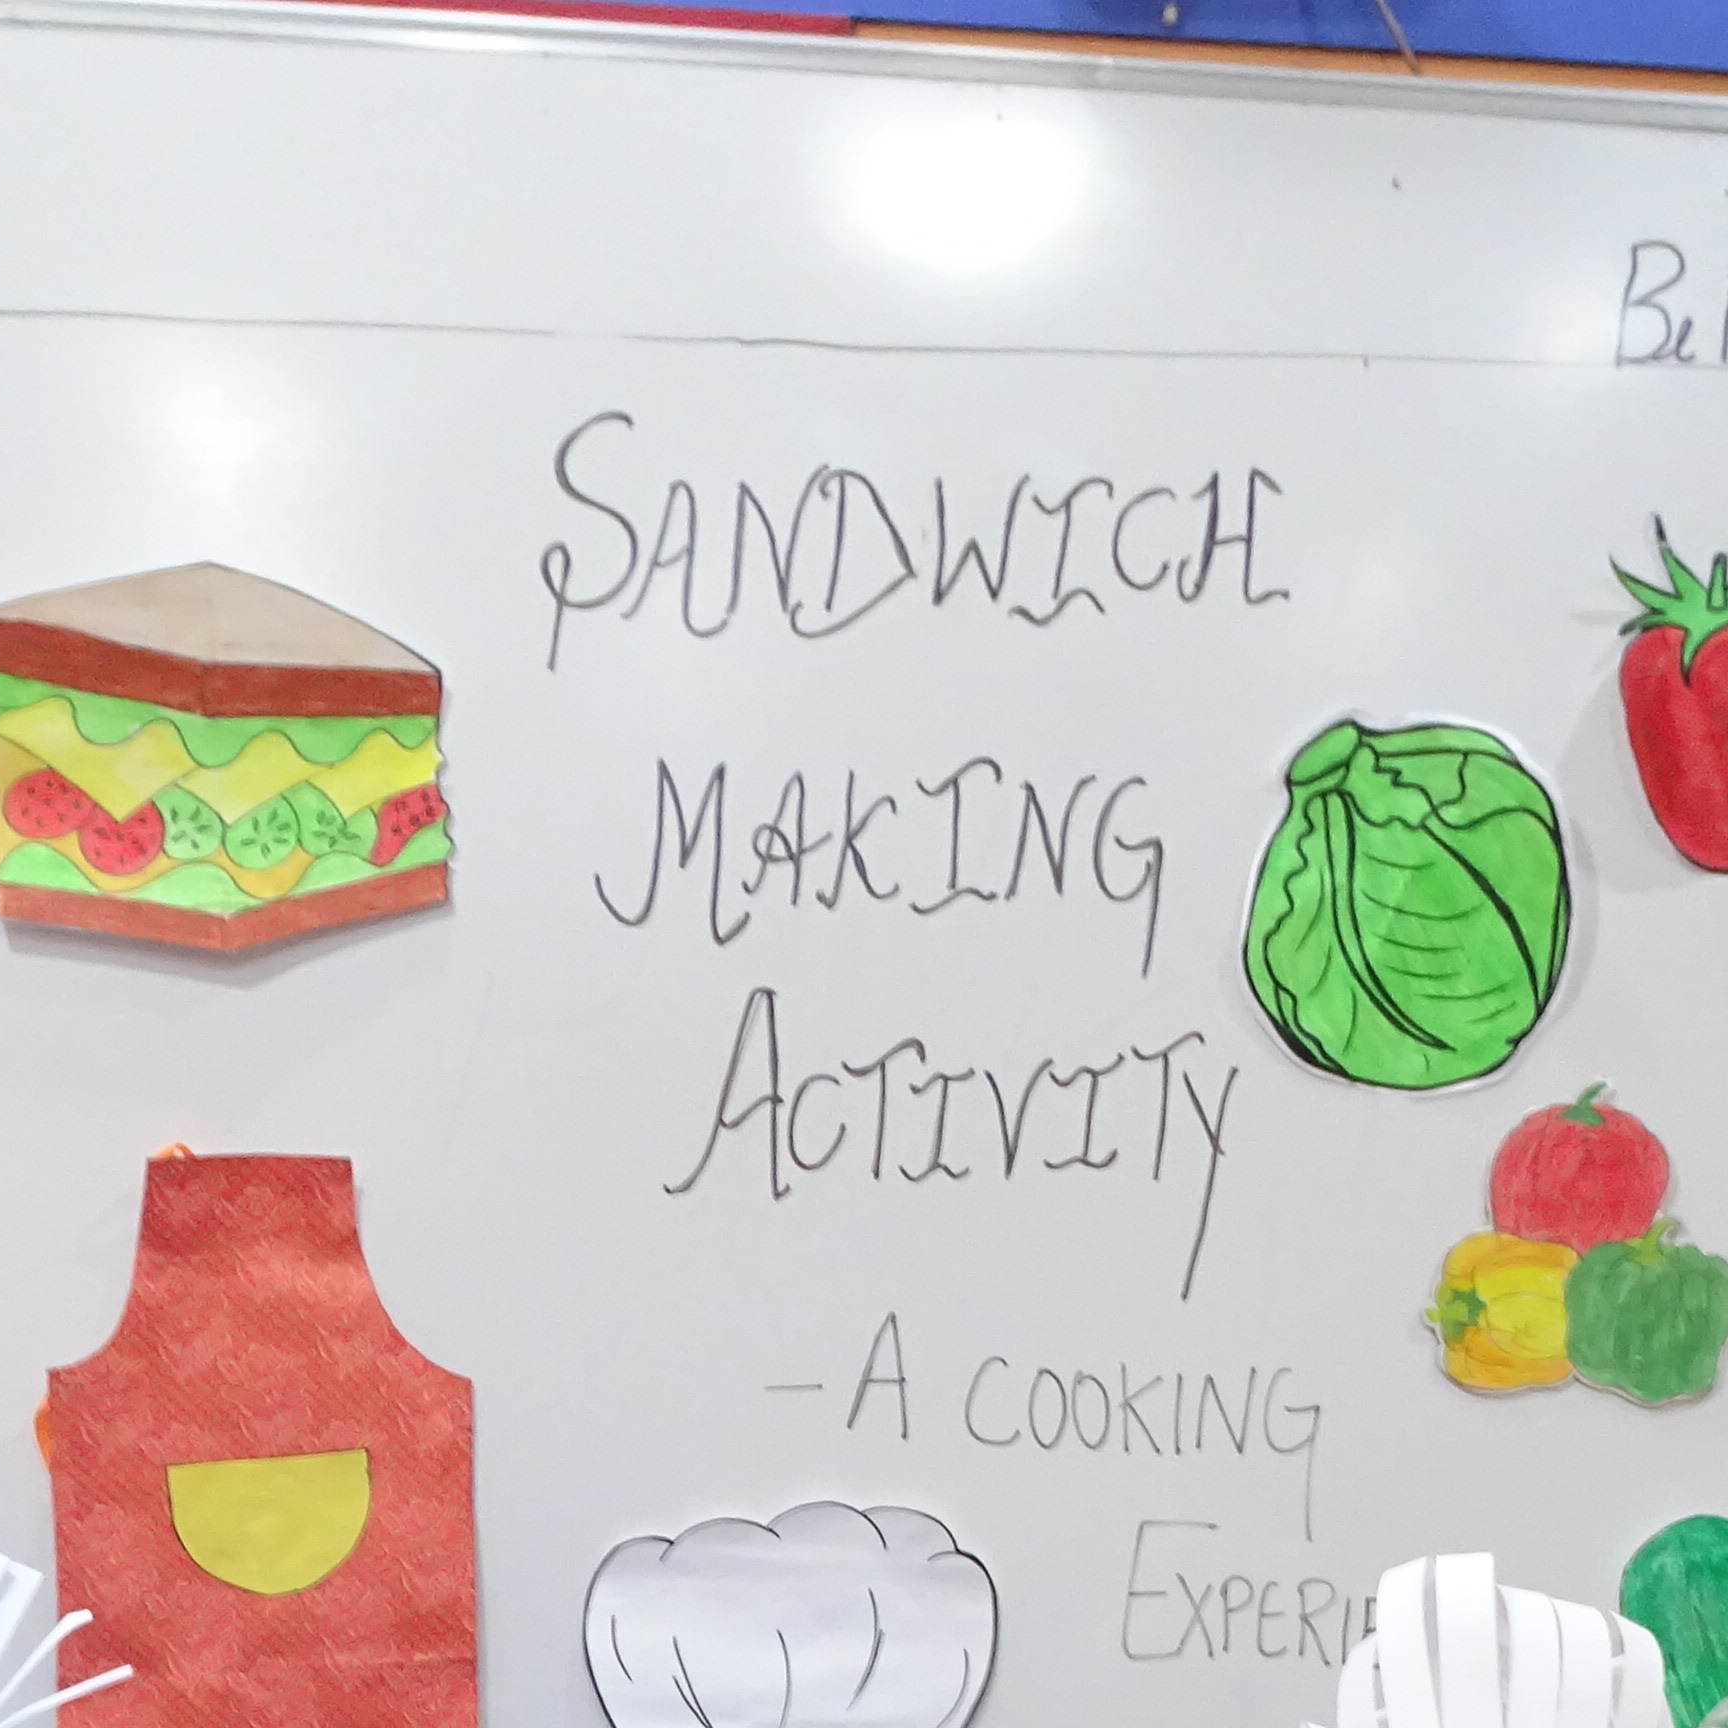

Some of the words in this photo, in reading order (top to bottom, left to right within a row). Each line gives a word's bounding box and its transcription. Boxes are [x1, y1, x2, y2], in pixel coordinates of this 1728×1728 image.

[1616, 239, 1695, 368] Be
[540, 410, 1290, 672] SANDWICH
[594, 756, 1166, 978] MAKING
[663, 986, 1239, 1301] ACTIVITY
[964, 1356, 1321, 1541] COOKING
